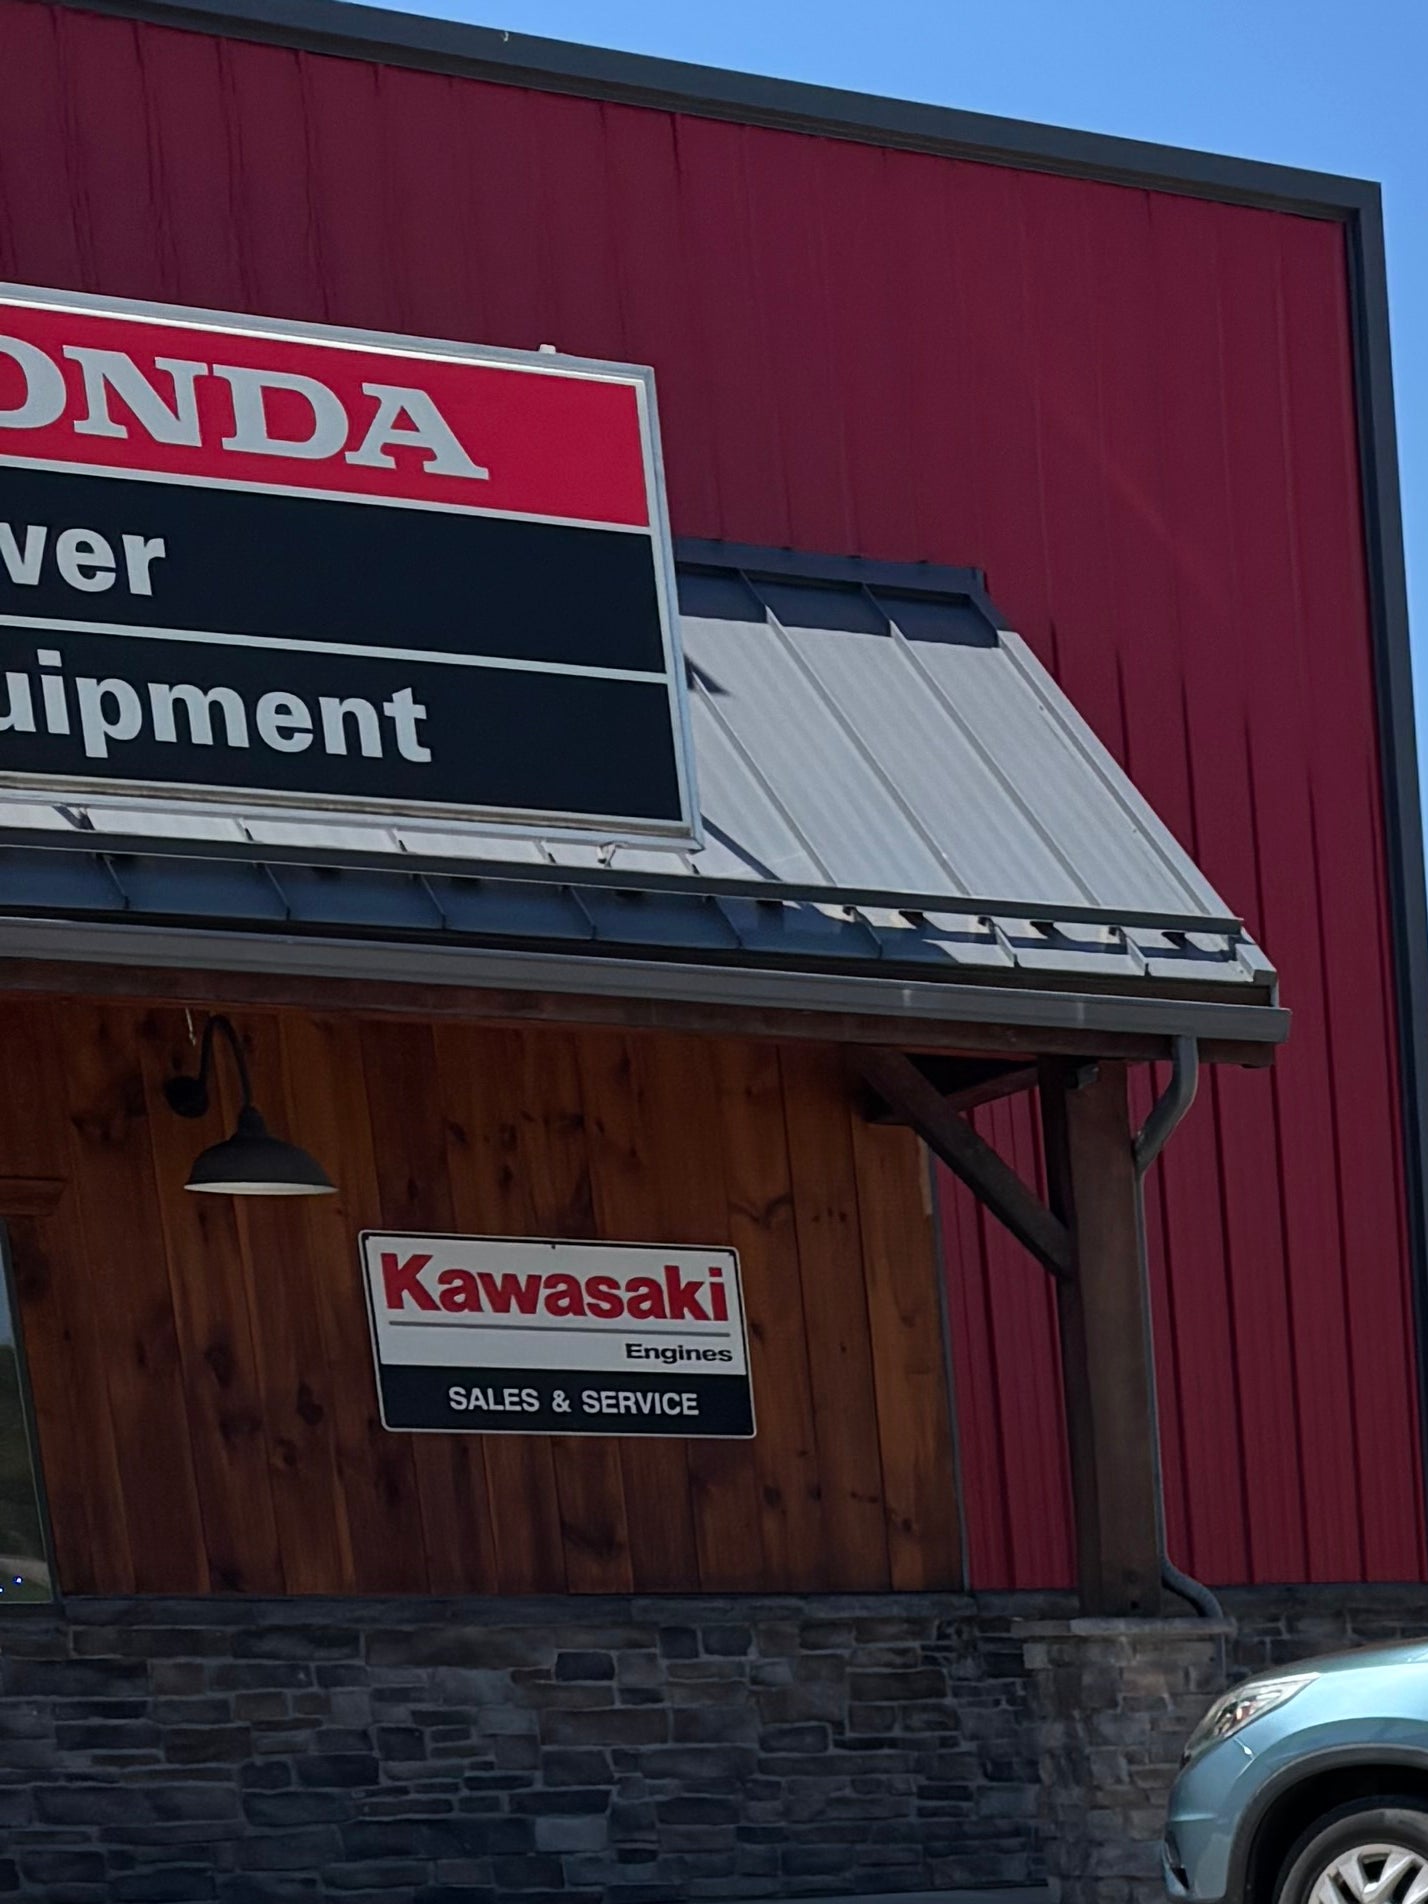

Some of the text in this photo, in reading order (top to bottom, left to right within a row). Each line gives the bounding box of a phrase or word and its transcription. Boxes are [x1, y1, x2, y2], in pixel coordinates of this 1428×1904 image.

[380, 1252, 729, 1323] Kawasaki
[625, 1343, 733, 1364] Engines
[448, 1386, 700, 1416] SALES & SERVICE
